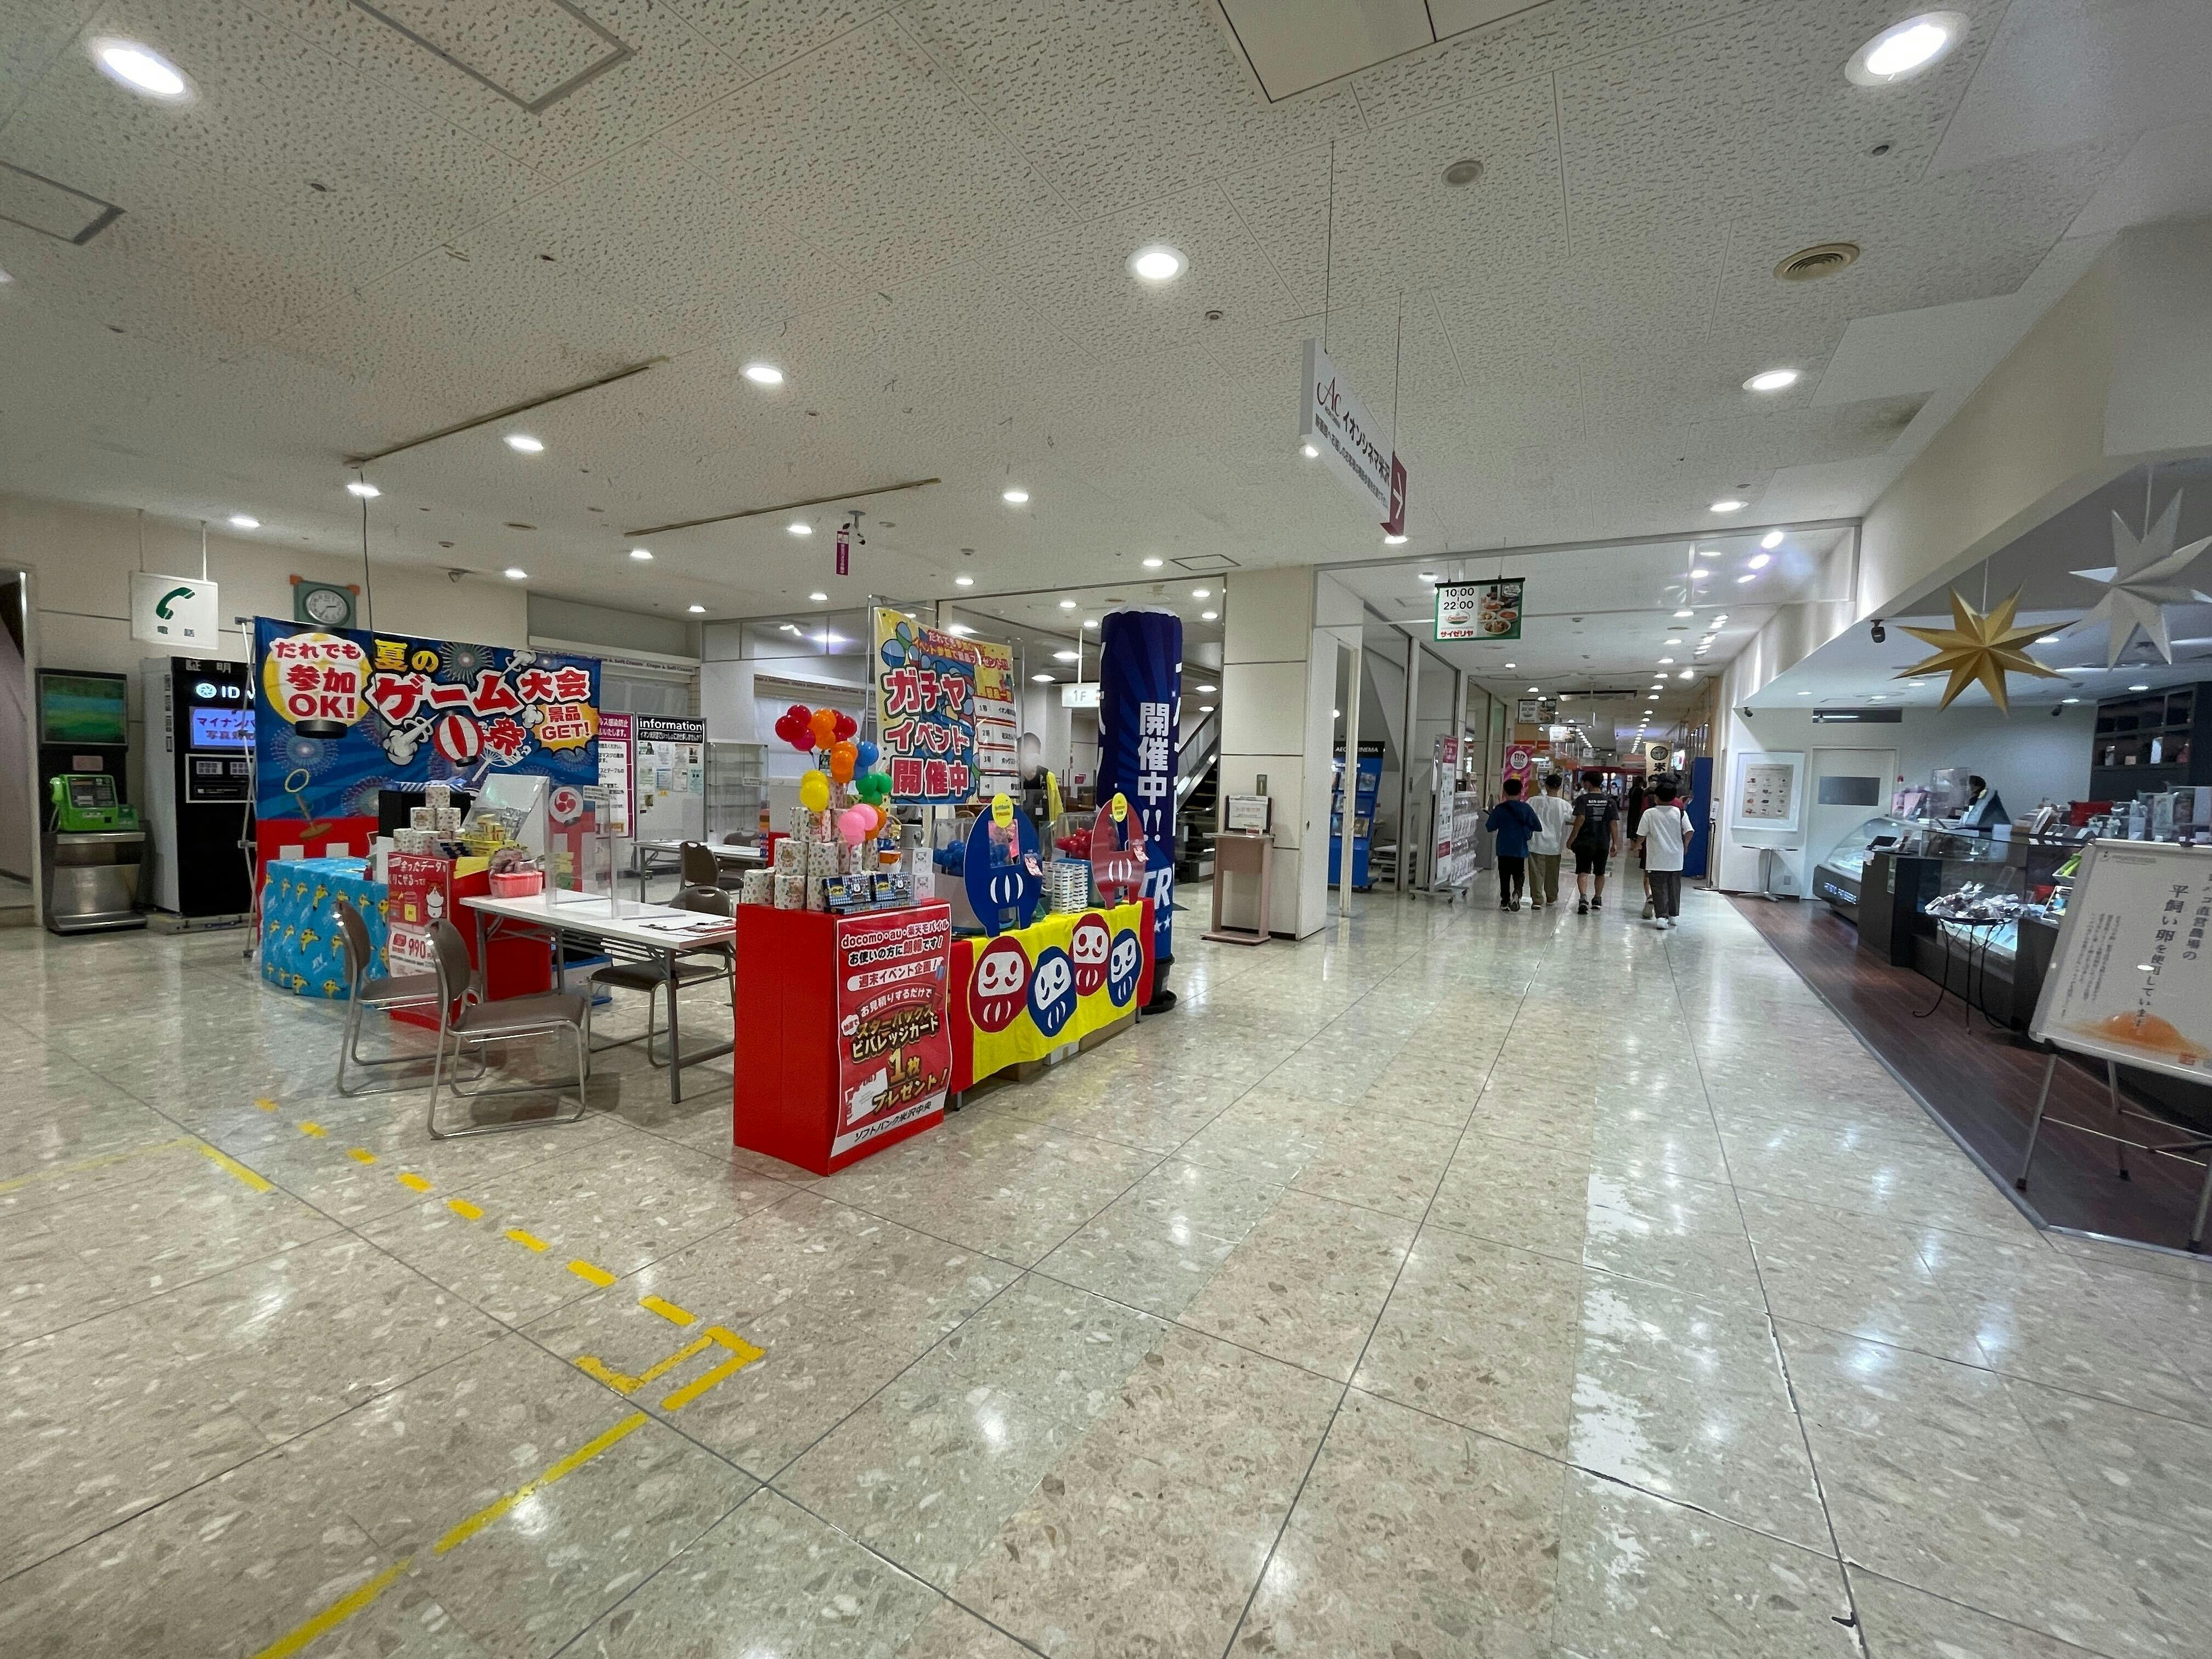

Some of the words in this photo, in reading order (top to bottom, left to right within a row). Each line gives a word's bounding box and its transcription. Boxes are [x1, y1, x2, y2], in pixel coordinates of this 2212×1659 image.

[1444, 601, 1474, 610] 22:00
[1445, 588, 1475, 597] 10:00
[1441, 630, 1474, 638] サイゼリヤ
[275, 641, 361, 659] だれでも
[375, 639, 438, 673] 夏の
[286, 664, 356, 693] 参加
[884, 667, 966, 714] ガチャ
[222, 686, 240, 698] ID
[1073, 690, 1087, 702] 1F
[288, 693, 355, 719] OK!
[549, 706, 579, 723] 景品
[489, 718, 524, 756] 祭
[542, 722, 590, 740] GET!
[640, 718, 702, 731] information
[885, 720, 969, 754] イベント
[892, 757, 968, 795] 開催中
[1138, 702, 1170, 842] 開催中!!
[409, 938, 426, 959] 990
[888, 1047, 920, 1082] 1枚
[873, 1069, 948, 1113] プレゼント!
[856, 1101, 932, 1142] ソフトバンク米沢中央
